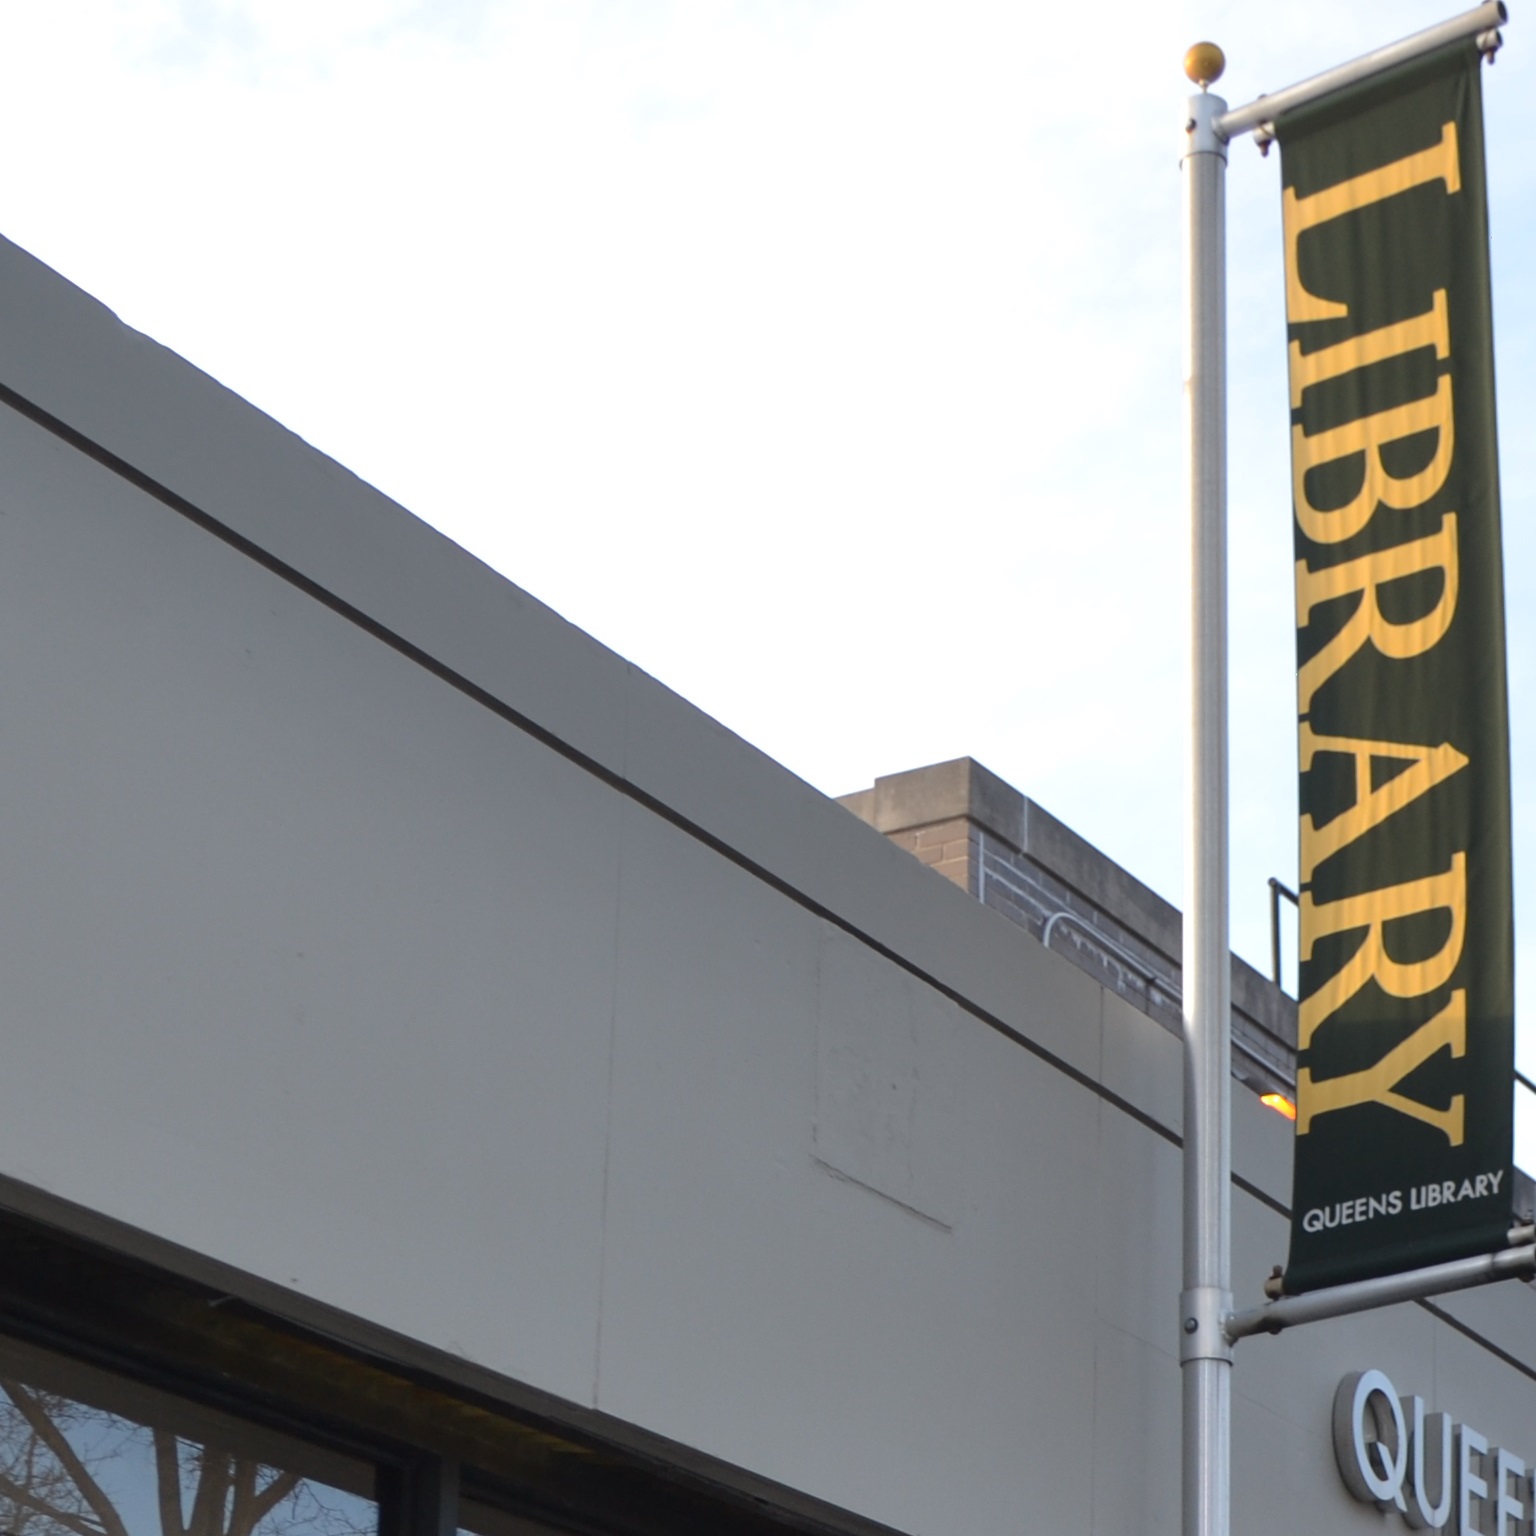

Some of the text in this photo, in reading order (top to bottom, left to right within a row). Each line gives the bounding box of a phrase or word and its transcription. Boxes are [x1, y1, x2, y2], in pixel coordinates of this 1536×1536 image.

[1283, 120, 1469, 1146] LIBRARY
[1303, 1170, 1504, 1233] QUEENS LIBRARY
